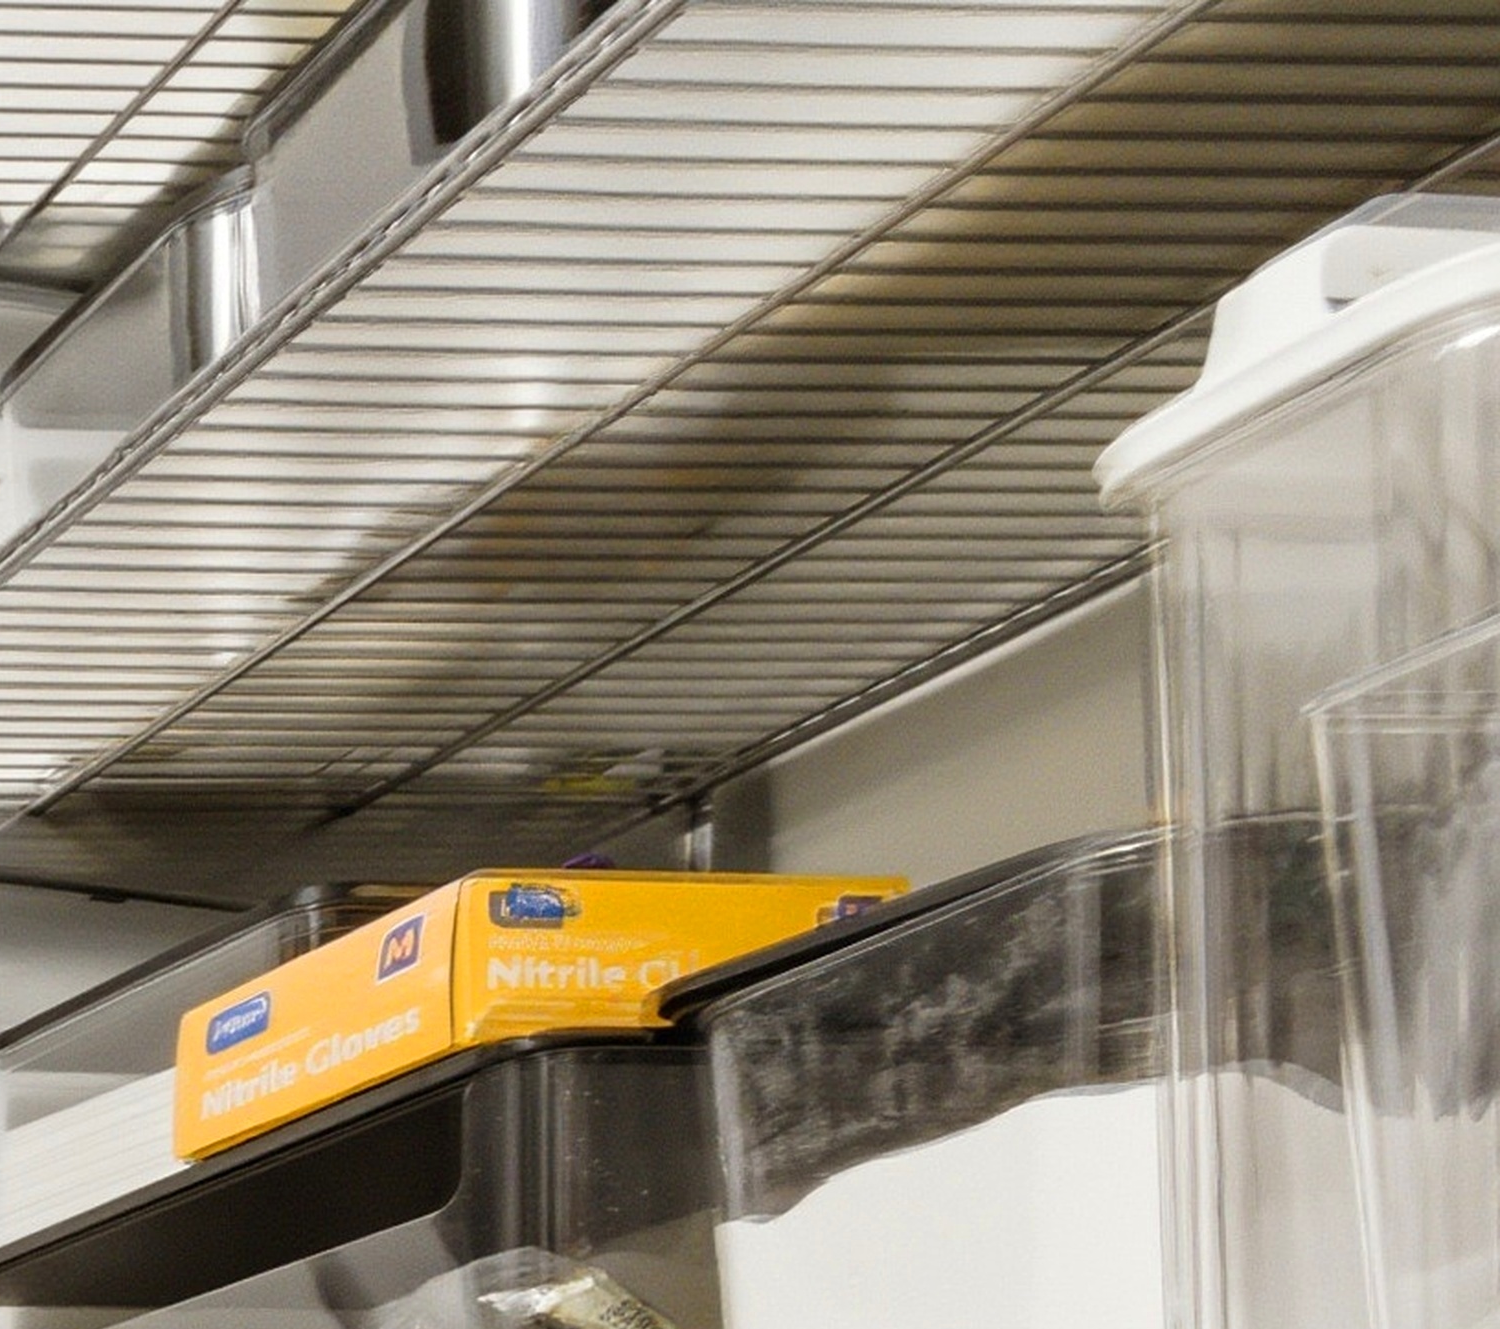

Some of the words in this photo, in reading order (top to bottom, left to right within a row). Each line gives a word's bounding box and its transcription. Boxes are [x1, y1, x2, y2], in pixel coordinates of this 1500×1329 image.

[487, 955, 627, 991] Nitrile
[200, 1059, 298, 1122] Nitrile
[305, 1006, 421, 1076] Gloves
